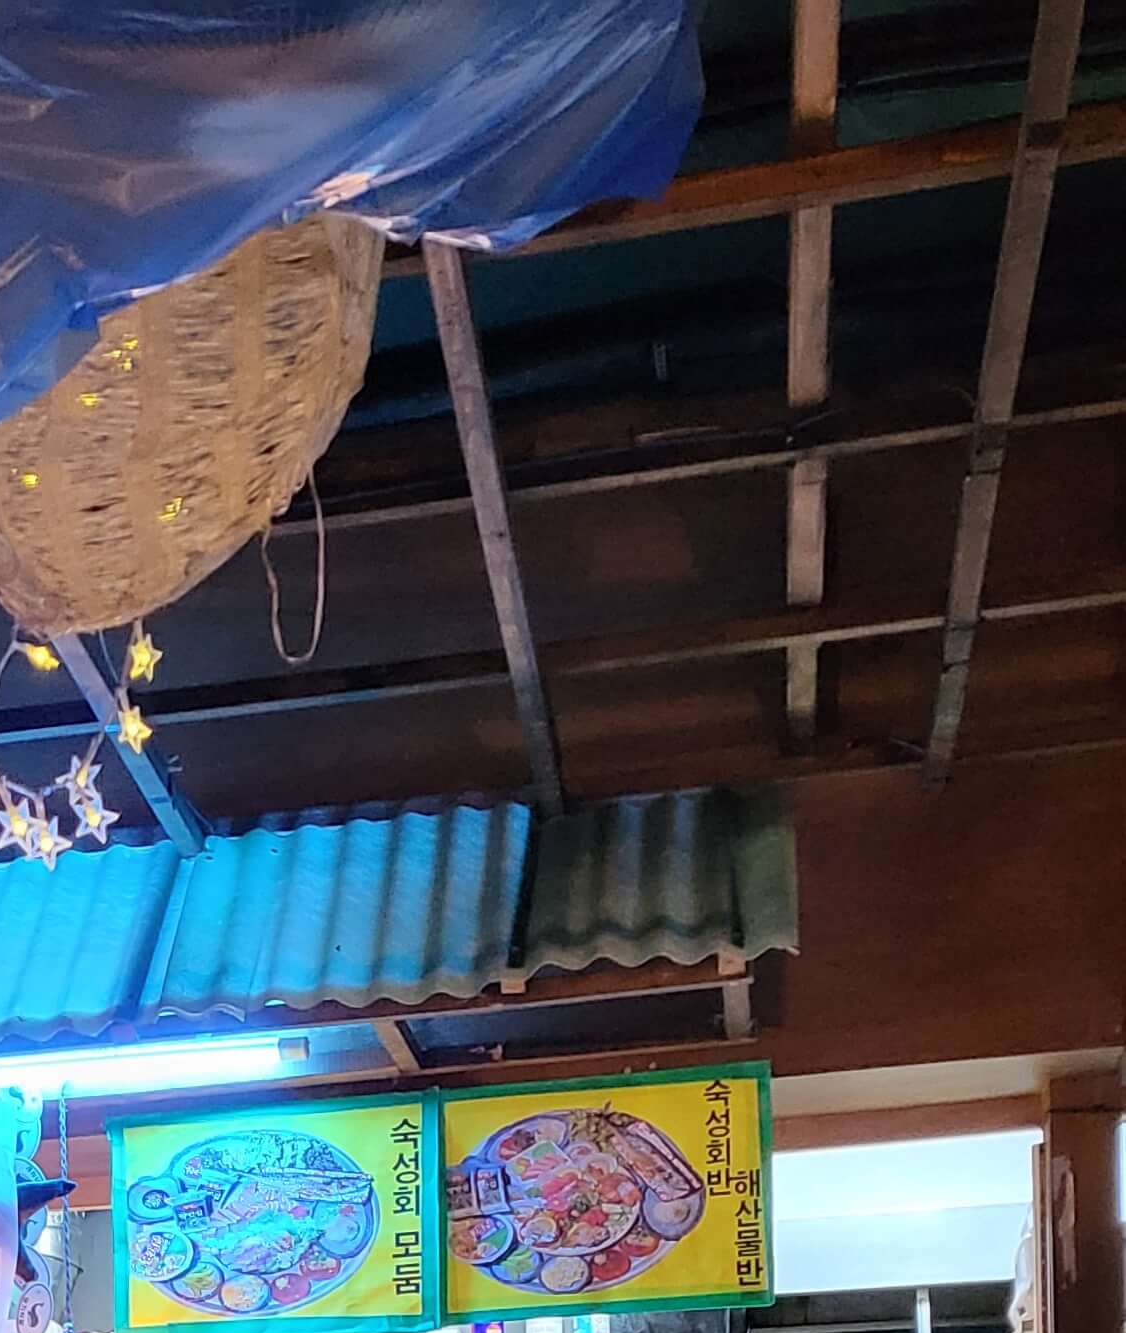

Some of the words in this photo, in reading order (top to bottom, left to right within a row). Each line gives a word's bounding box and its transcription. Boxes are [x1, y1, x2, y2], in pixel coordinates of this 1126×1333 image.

[390, 1118, 422, 1217] 숙성회
[703, 1080, 733, 1197] 숙성회반
[391, 1231, 423, 1296] 모둠
[733, 1168, 764, 1287] 해산물반
